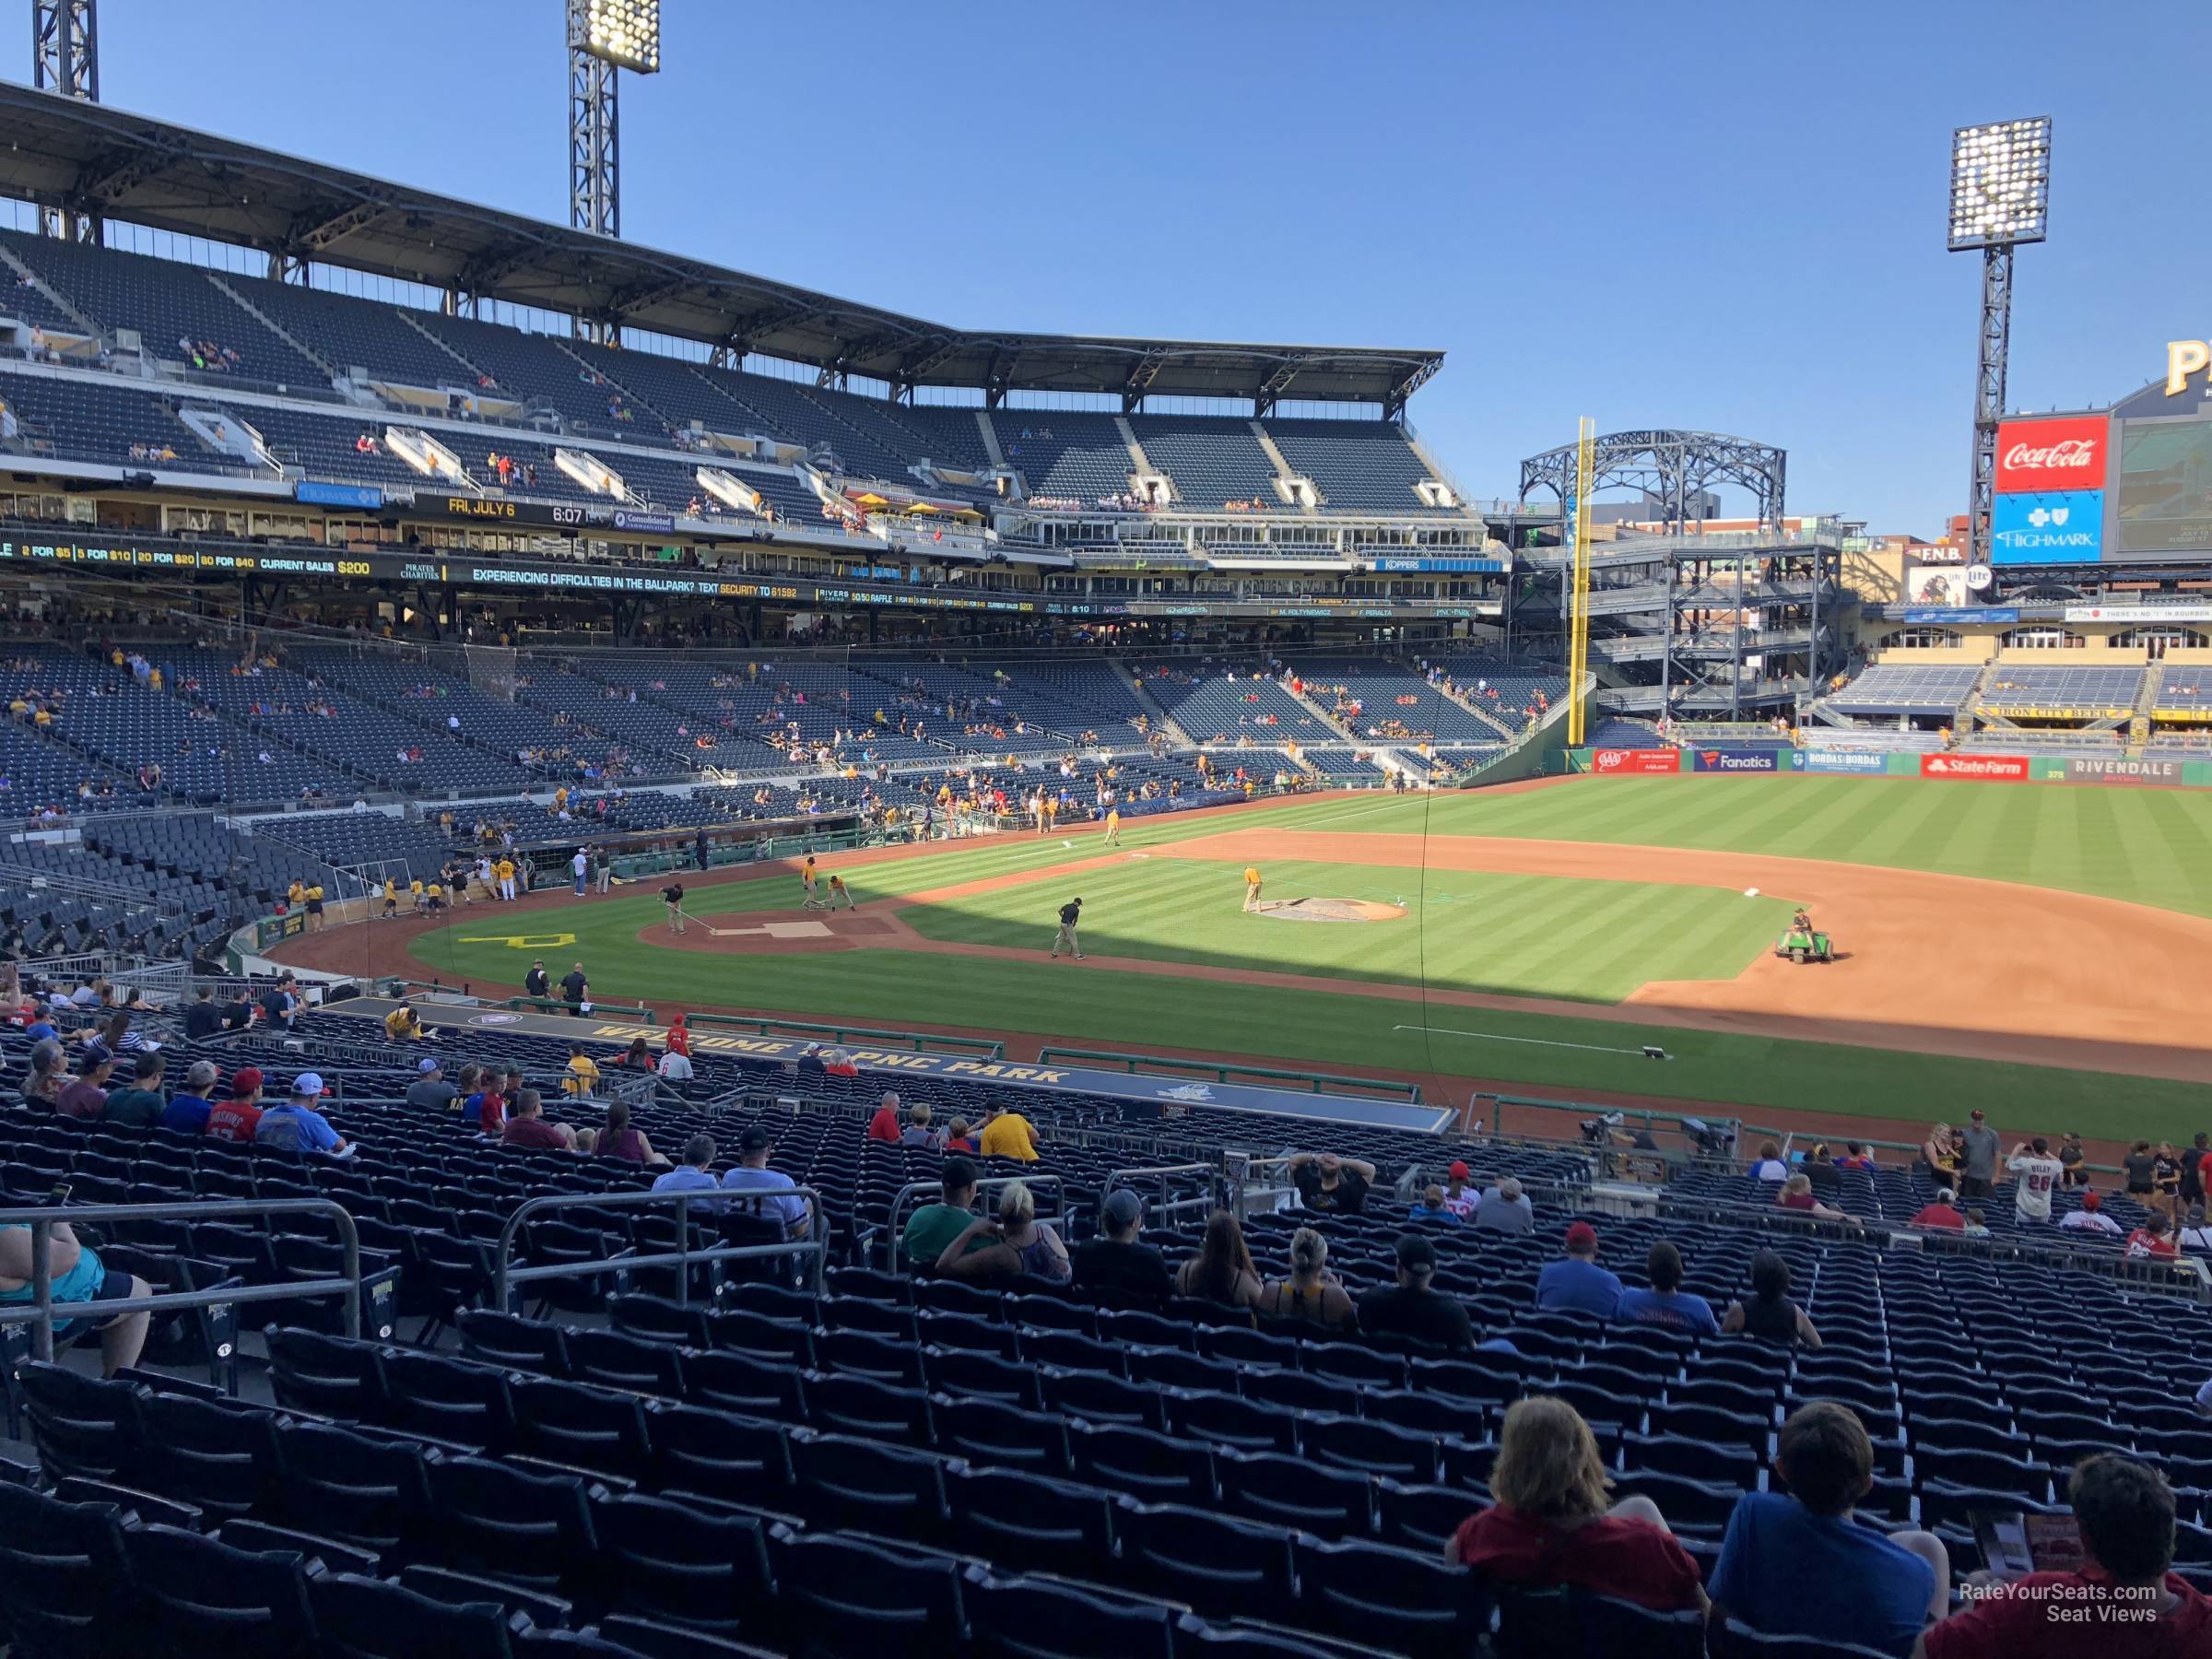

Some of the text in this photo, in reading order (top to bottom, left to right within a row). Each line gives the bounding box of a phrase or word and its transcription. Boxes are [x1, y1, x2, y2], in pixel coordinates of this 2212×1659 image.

[2004, 440, 2099, 470] Coca-Cola
[449, 499, 515, 516] FRI, JULY 6
[553, 507, 582, 524] 6:07
[628, 514, 671, 526] Consolidated
[1996, 529, 2098, 547] HIGHMARK
[32, 546, 54, 558] FOR
[56, 547, 71, 559] $5
[87, 548, 108, 560] FOR
[110, 549, 131, 561] $10
[154, 551, 173, 564] FOR
[175, 552, 194, 565] $20
[1922, 547, 1962, 561] F.N.B.
[216, 556, 234, 567] FOR
[236, 557, 254, 568] $40
[260, 559, 304, 571] CURRENT
[305, 559, 335, 572] SALES
[338, 561, 371, 574] $200
[406, 564, 435, 572] PIRATES
[1385, 559, 1419, 569] KOPPERS
[400, 571, 439, 580] CHARITIES
[1969, 571, 1989, 582] Lite
[473, 569, 548, 583] EXPERIENCING
[551, 573, 612, 587] DIFFICULTIES
[614, 577, 624, 588] IN
[626, 578, 643, 589] THE
[645, 579, 694, 592] BALLPARK?
[698, 582, 719, 594] TEXT
[721, 583, 759, 595] SECURITY
[759, 586, 771, 596] TO
[819, 589, 849, 597] RIVERS
[852, 593, 870, 602] 50/50
[871, 594, 892, 604] RAFFLE
[1018, 602, 1034, 611] $200
[1998, 708, 2109, 719] IRON CITY BEER
[1721, 755, 1771, 769] Fanatics
[1809, 753, 1880, 766] BORDAS BORDAS
[2076, 760, 2172, 775] RIVENDALE
[849, 1051, 941, 1069] PNC
[942, 1061, 1070, 1083] PARK
